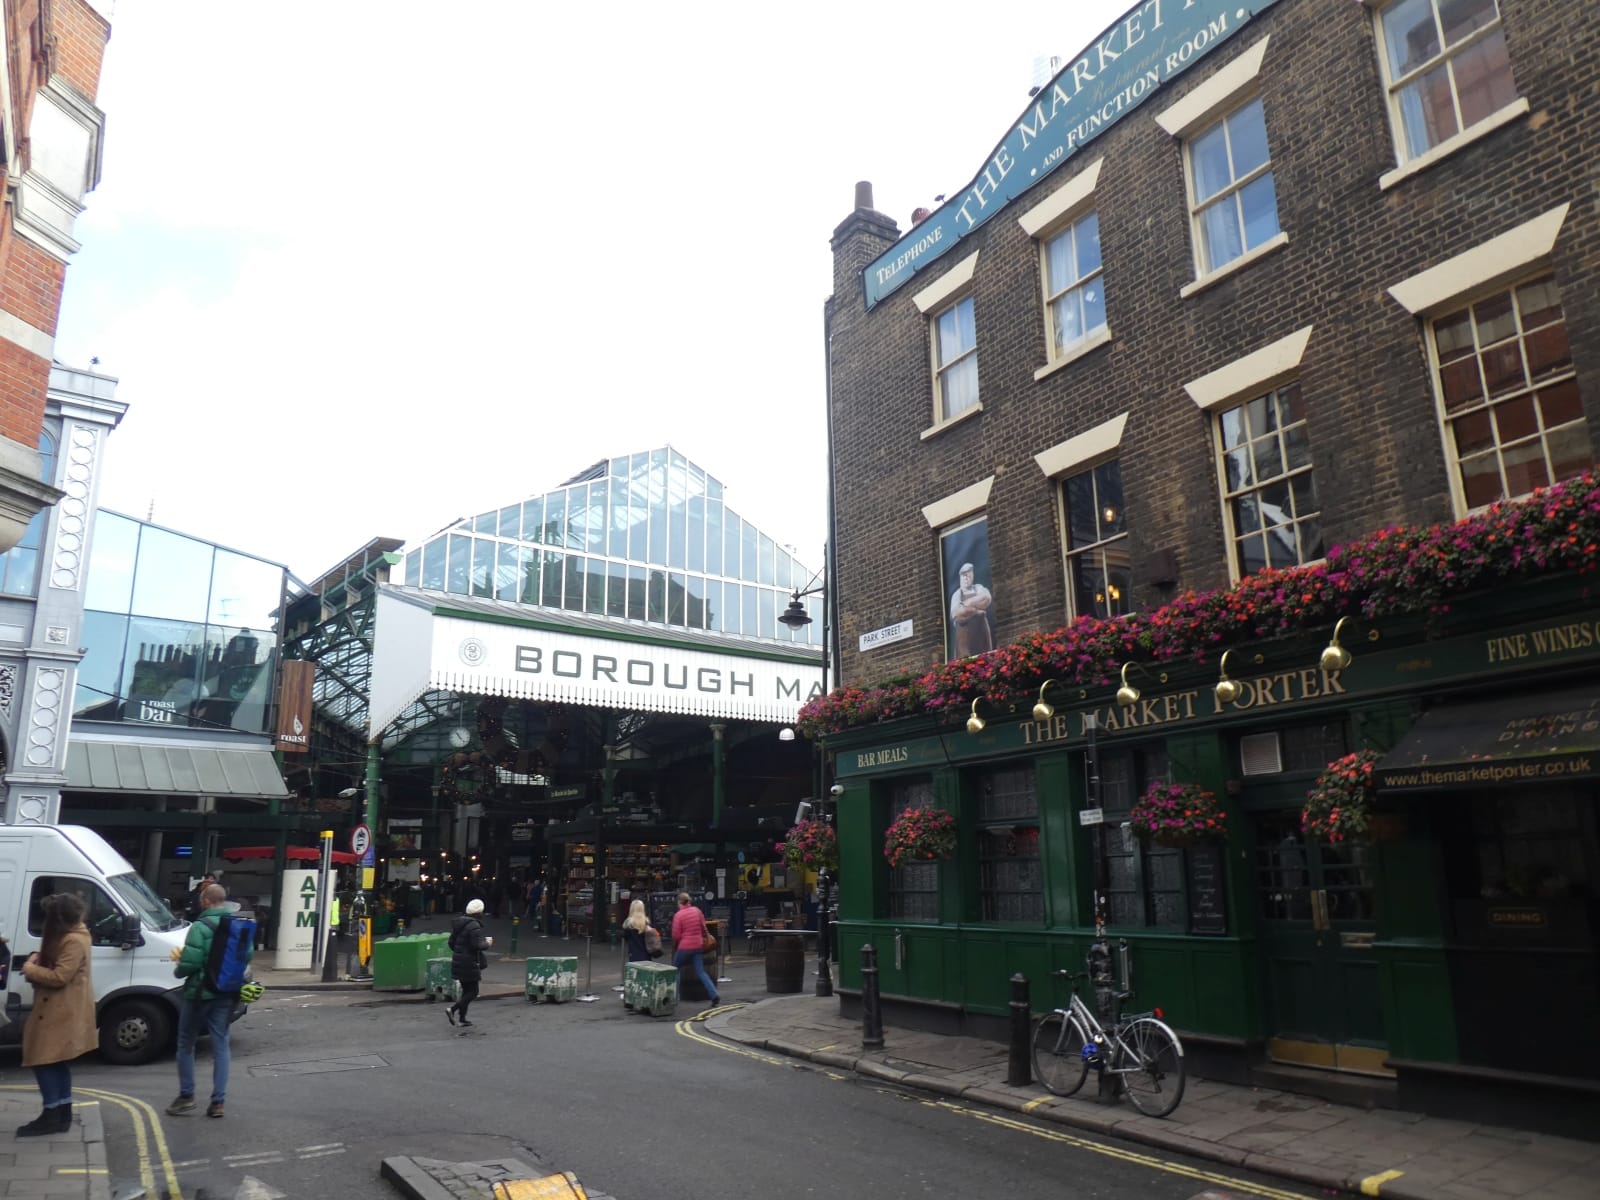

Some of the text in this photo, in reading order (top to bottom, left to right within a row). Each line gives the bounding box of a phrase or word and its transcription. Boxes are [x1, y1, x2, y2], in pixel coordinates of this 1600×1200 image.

[1042, 12, 1228, 168] AND FUNCTION ROOM
[954, 0, 1165, 229] THE MARKET
[876, 225, 943, 286] TELEPHONE
[863, 632, 879, 645] PARK
[881, 624, 901, 640] STREET
[1487, 634, 1529, 663] FINE
[1531, 622, 1593, 655] WINES
[515, 645, 754, 697] BOROUGH
[140, 700, 177, 722] bar
[1019, 715, 1068, 744] THE
[857, 753, 876, 768] BAR
[877, 746, 909, 765] MEALS
[1384, 758, 1592, 787] www.themarketporter.co.uk
[296, 875, 317, 928] ATM
